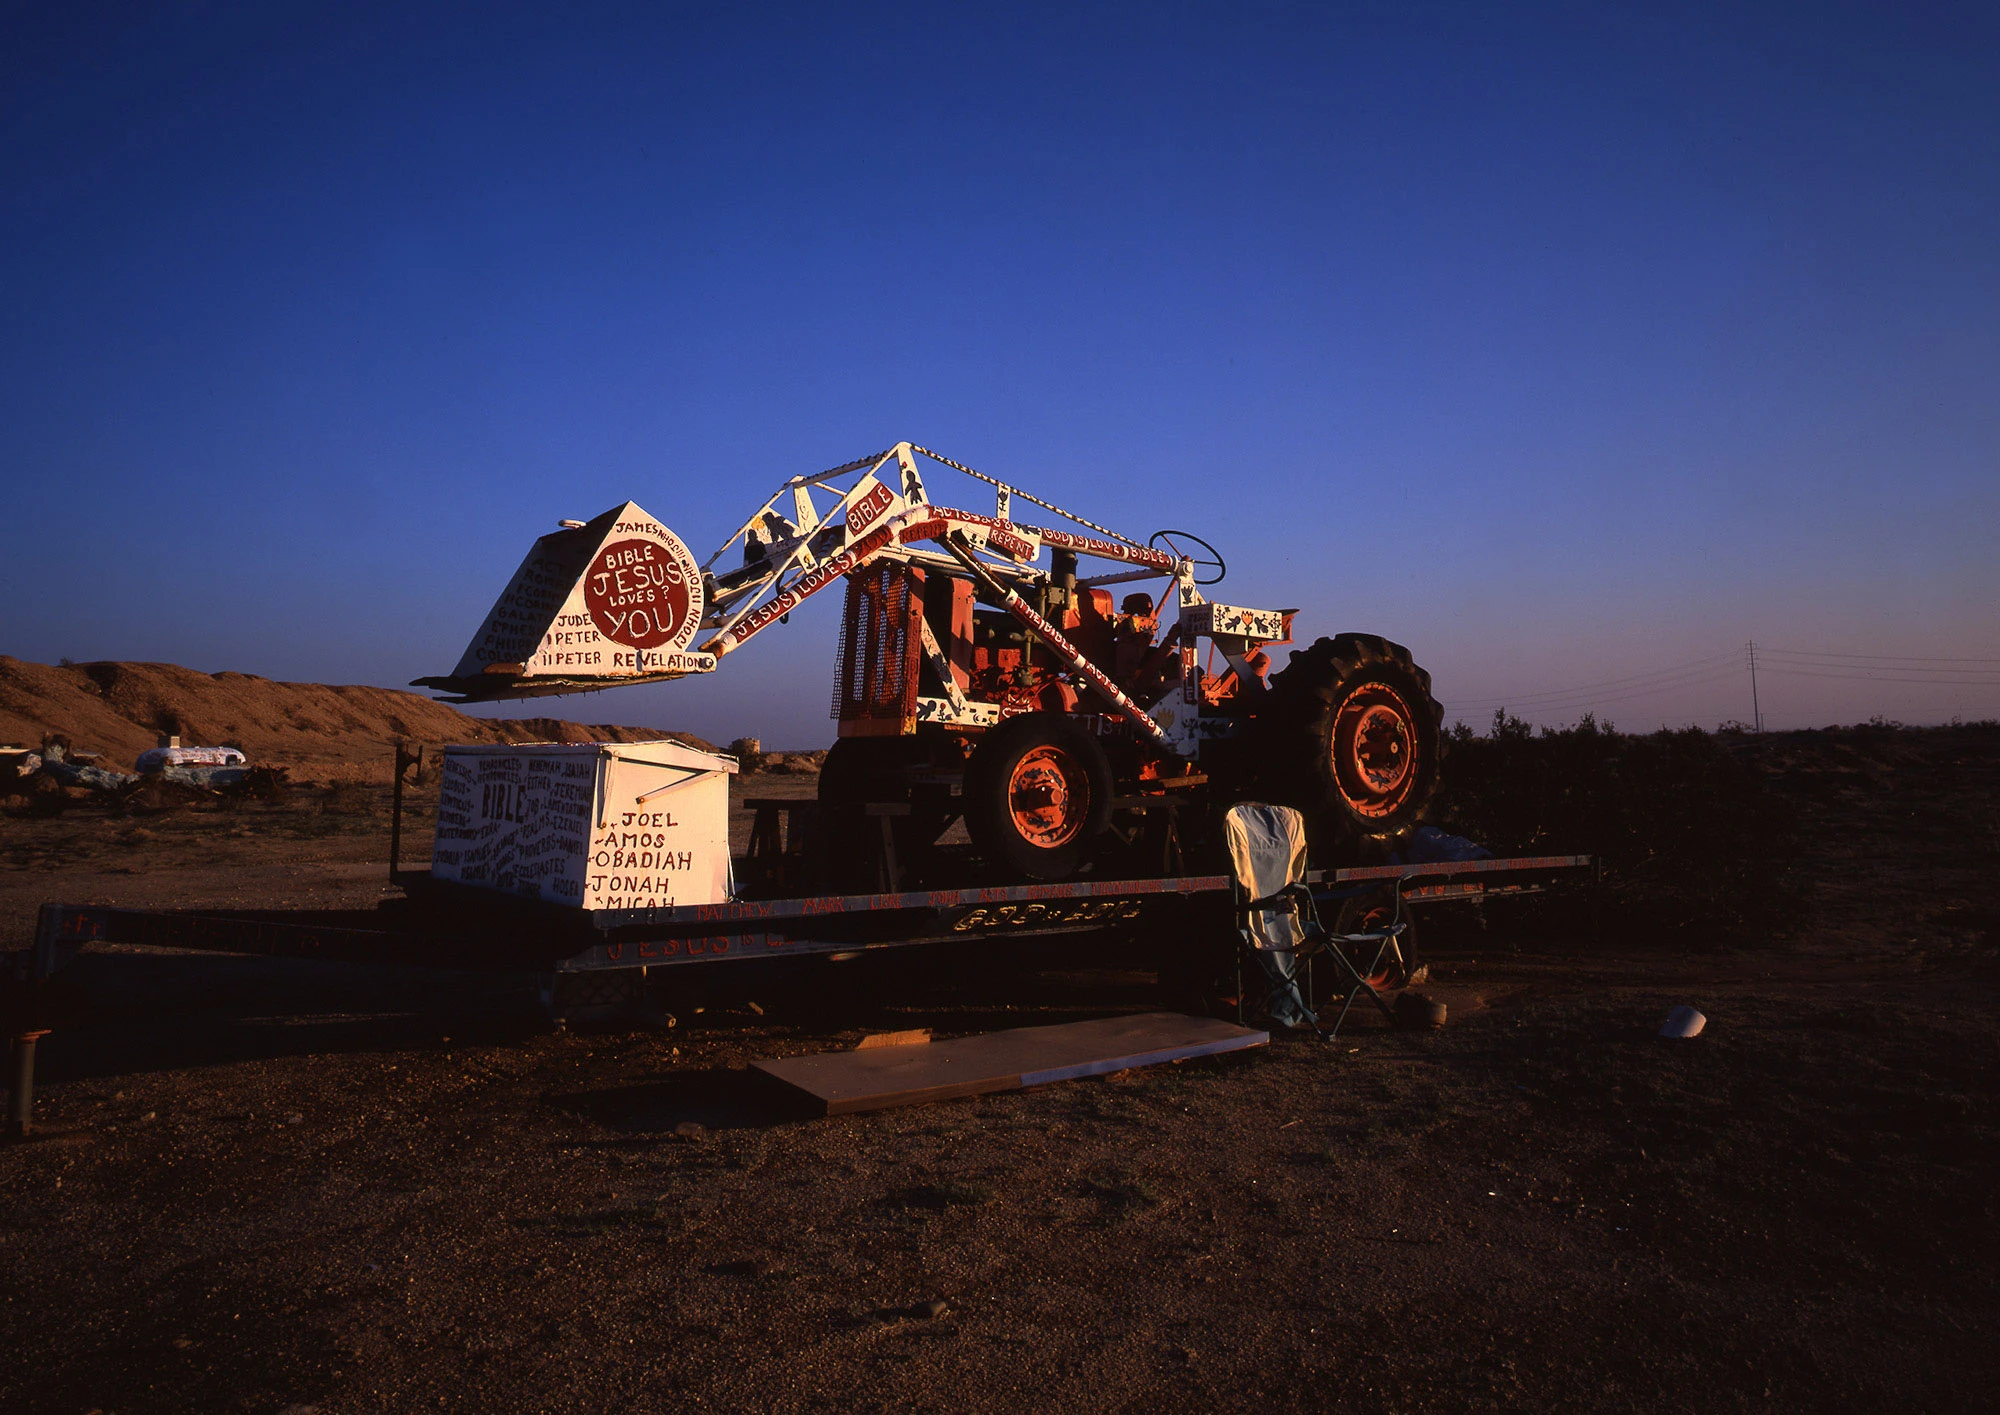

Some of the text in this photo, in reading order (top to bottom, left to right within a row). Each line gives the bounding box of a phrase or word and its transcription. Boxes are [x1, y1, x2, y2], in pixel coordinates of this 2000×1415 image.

[848, 486, 890, 531] BIBLE
[933, 506, 970, 521] ACTS
[615, 521, 658, 535] JAMES
[991, 529, 1032, 557] REPENT
[1044, 527, 1121, 554] GOD IS LOVE
[605, 544, 654, 569] BIBLE
[593, 561, 682, 596] JESUS
[609, 589, 655, 607] LOVES
[735, 593, 792, 637] JESUS
[800, 555, 850, 594] LOVES
[558, 612, 591, 627] JUDE
[604, 603, 674, 638] YOU
[556, 631, 601, 645] PETER
[1017, 597, 1044, 626] THE
[1043, 621, 1077, 656] BIBLE
[1086, 663, 1118, 694] ACTS
[556, 651, 601, 665] PETER
[613, 652, 701, 668] REVELATION
[482, 784, 526, 823] BIBLE
[622, 812, 679, 827] JOEL
[604, 831, 666, 848] AMOS
[595, 850, 692, 871] OBADIAH
[591, 875, 669, 894] JONAH
[606, 896, 675, 909] MICAH
